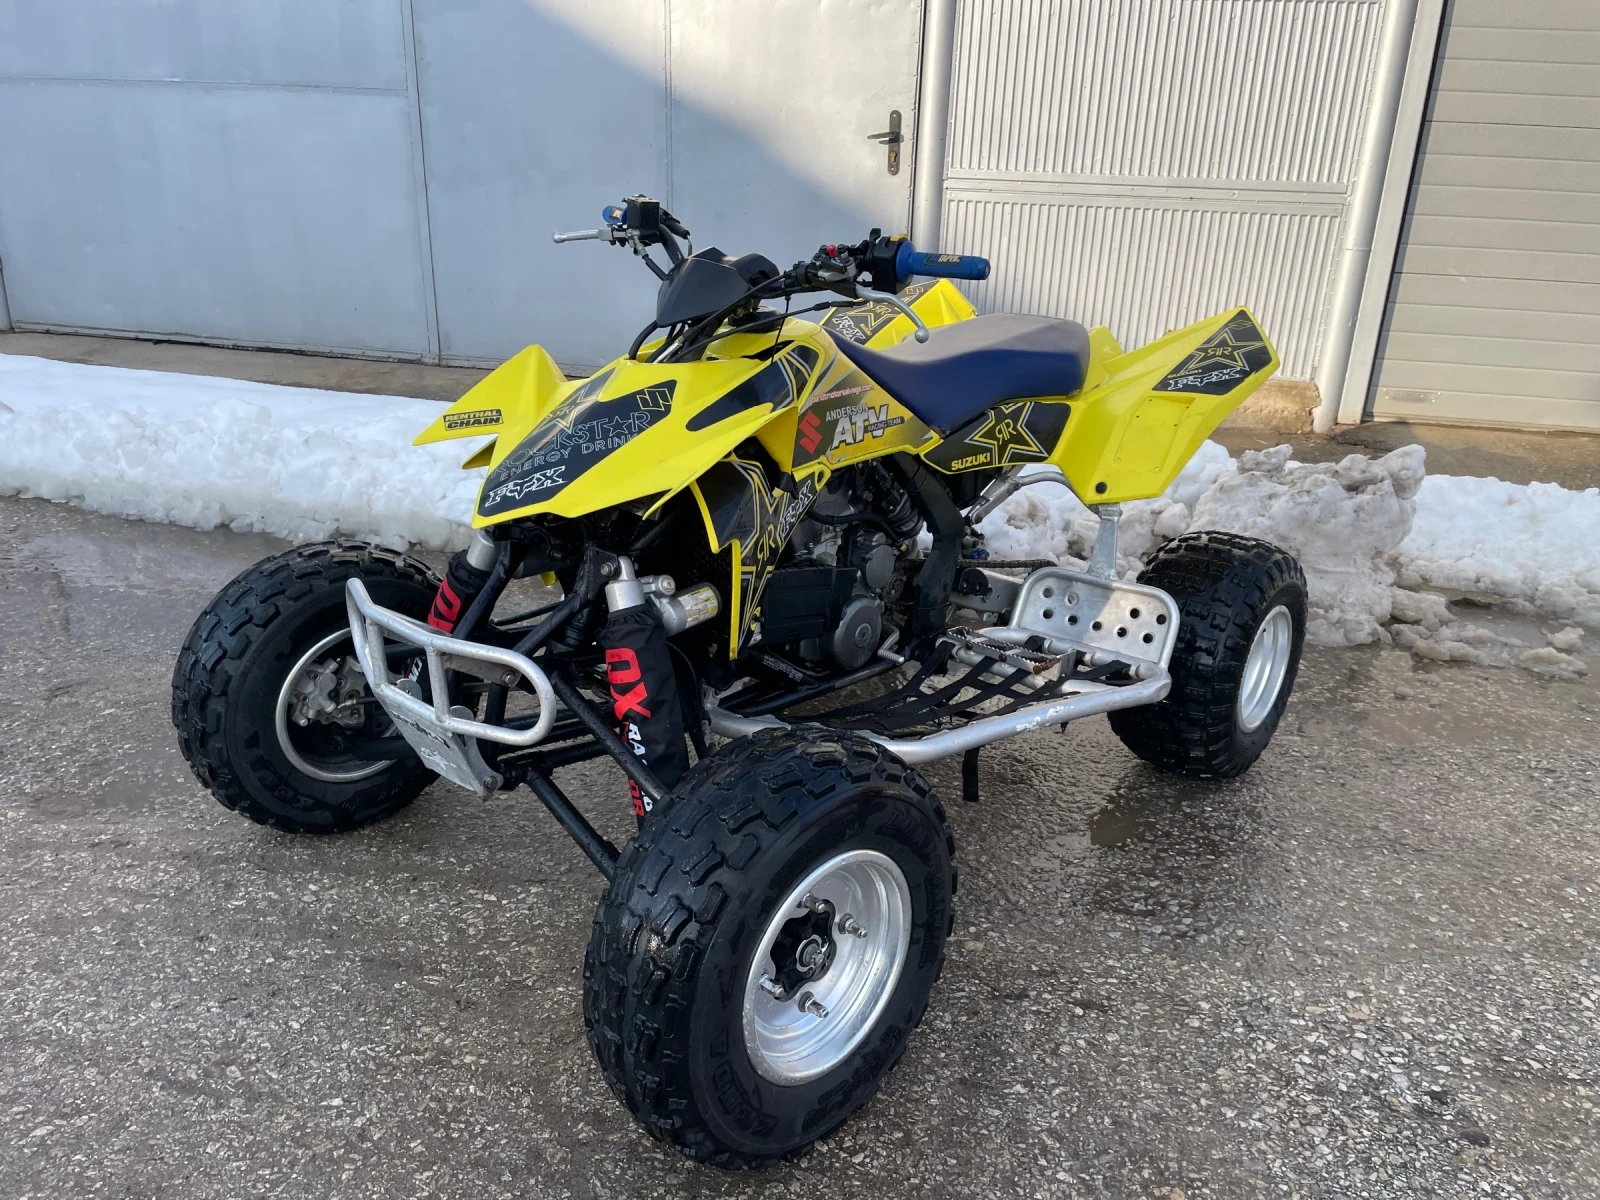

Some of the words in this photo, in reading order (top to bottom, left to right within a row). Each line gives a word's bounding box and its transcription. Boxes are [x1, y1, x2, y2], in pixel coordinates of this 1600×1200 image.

[445, 409, 500, 421] RENTHAL
[826, 404, 869, 422] ANDERSON
[447, 417, 501, 429] CHAIN
[830, 403, 889, 451] ATV
[868, 420, 887, 431] RACING
[888, 417, 901, 427] TEAM
[499, 447, 571, 481] ENERGY
[951, 452, 990, 471] SUZUKI
[485, 465, 568, 507] FOX
